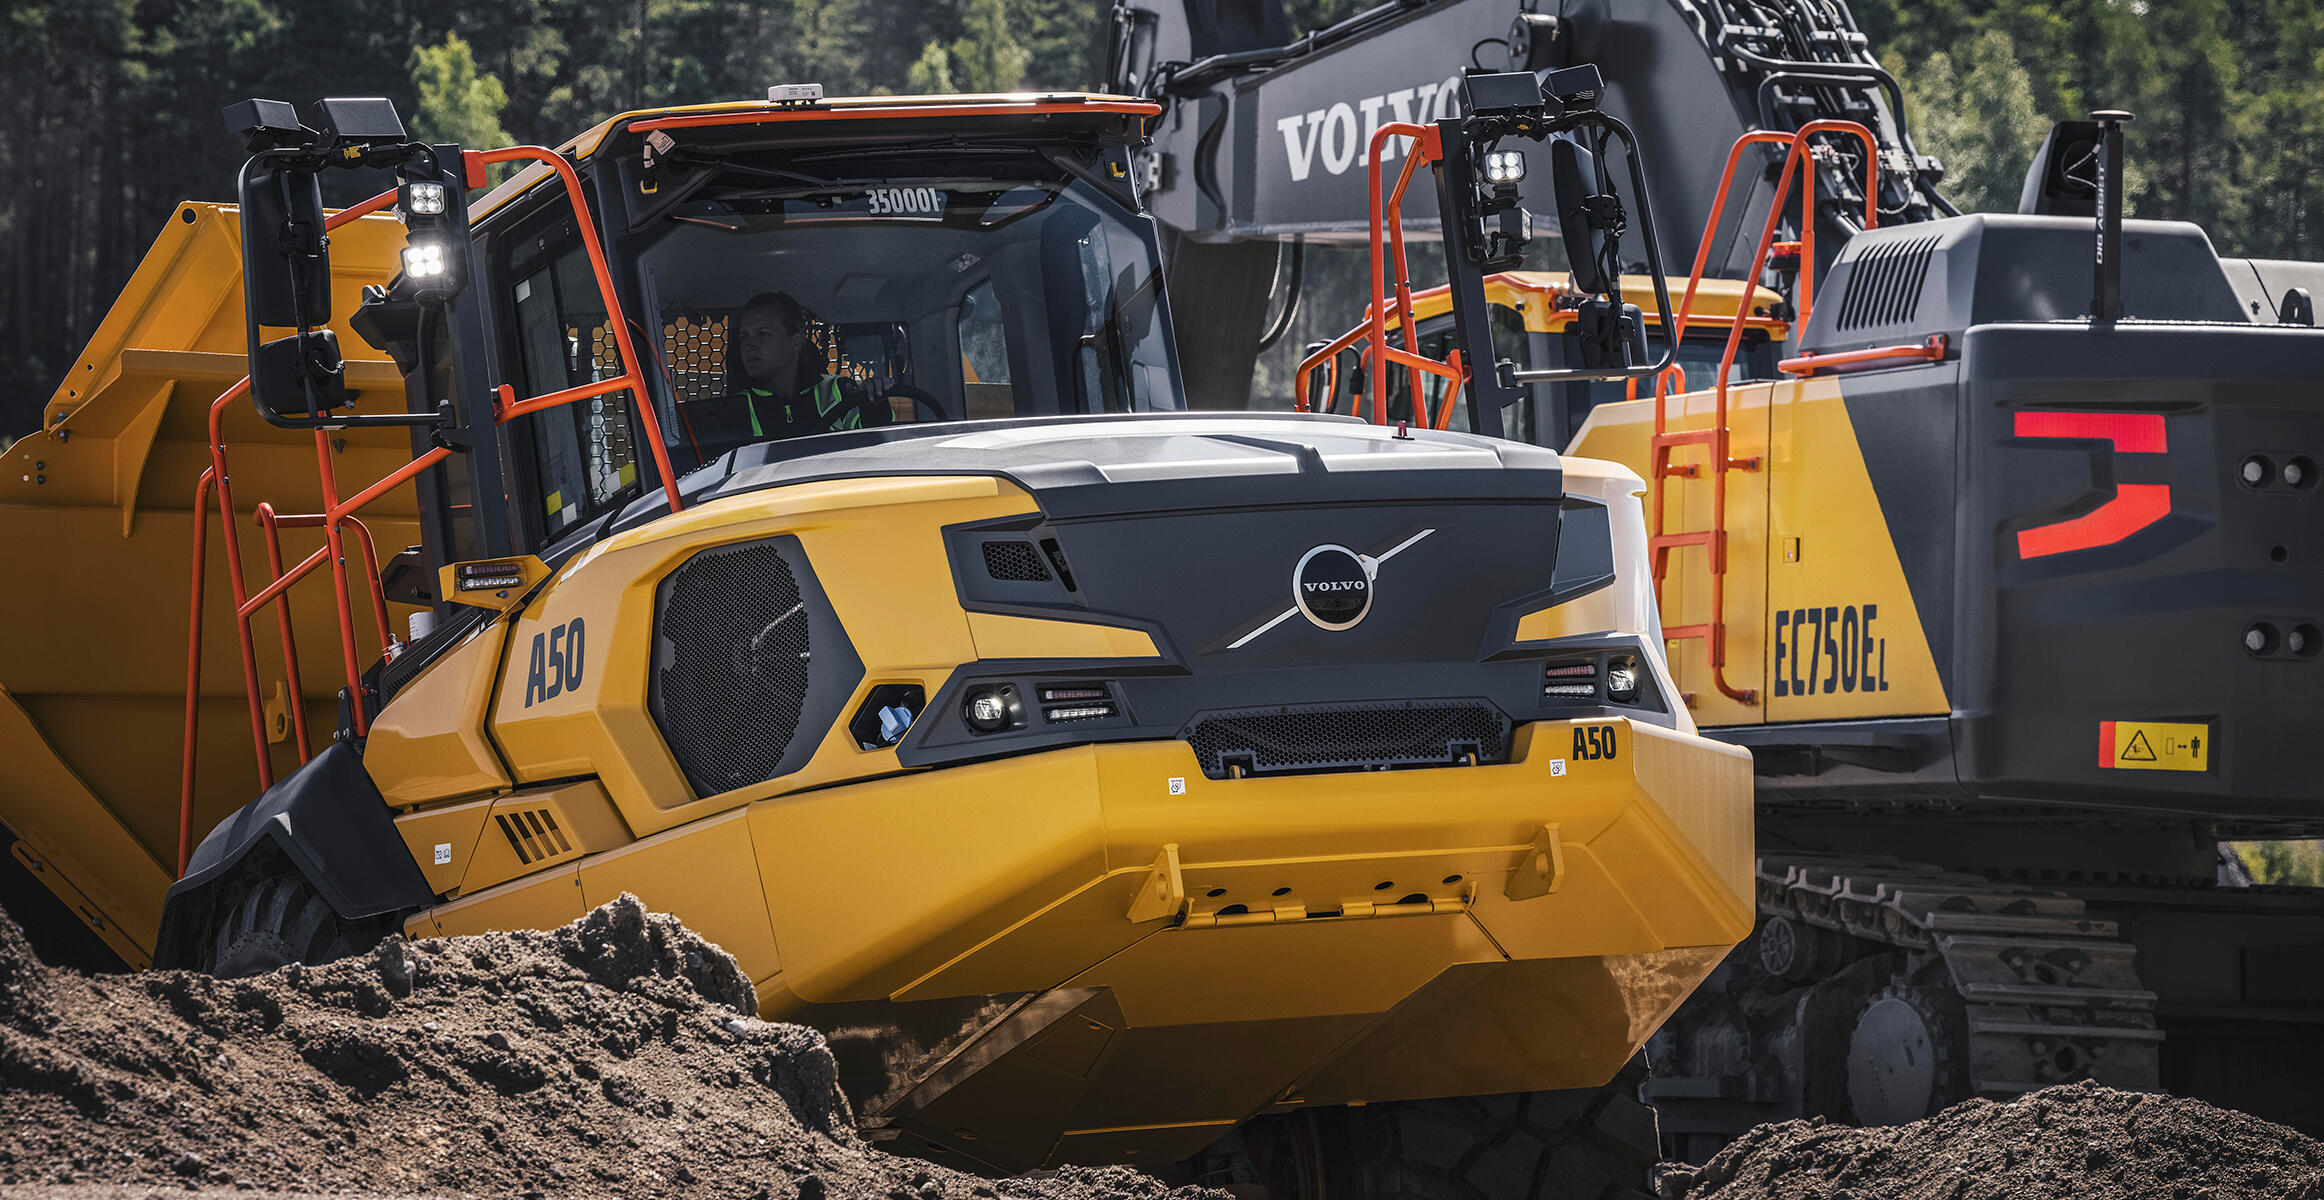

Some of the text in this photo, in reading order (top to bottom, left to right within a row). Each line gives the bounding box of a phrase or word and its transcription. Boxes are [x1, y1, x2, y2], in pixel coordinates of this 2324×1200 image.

[865, 187, 940, 214] 350001
[2096, 164, 2105, 264] DIG ASSIST
[1304, 580, 1366, 592] VOLVO
[525, 617, 585, 708] A50
[1572, 726, 1617, 760] A50
